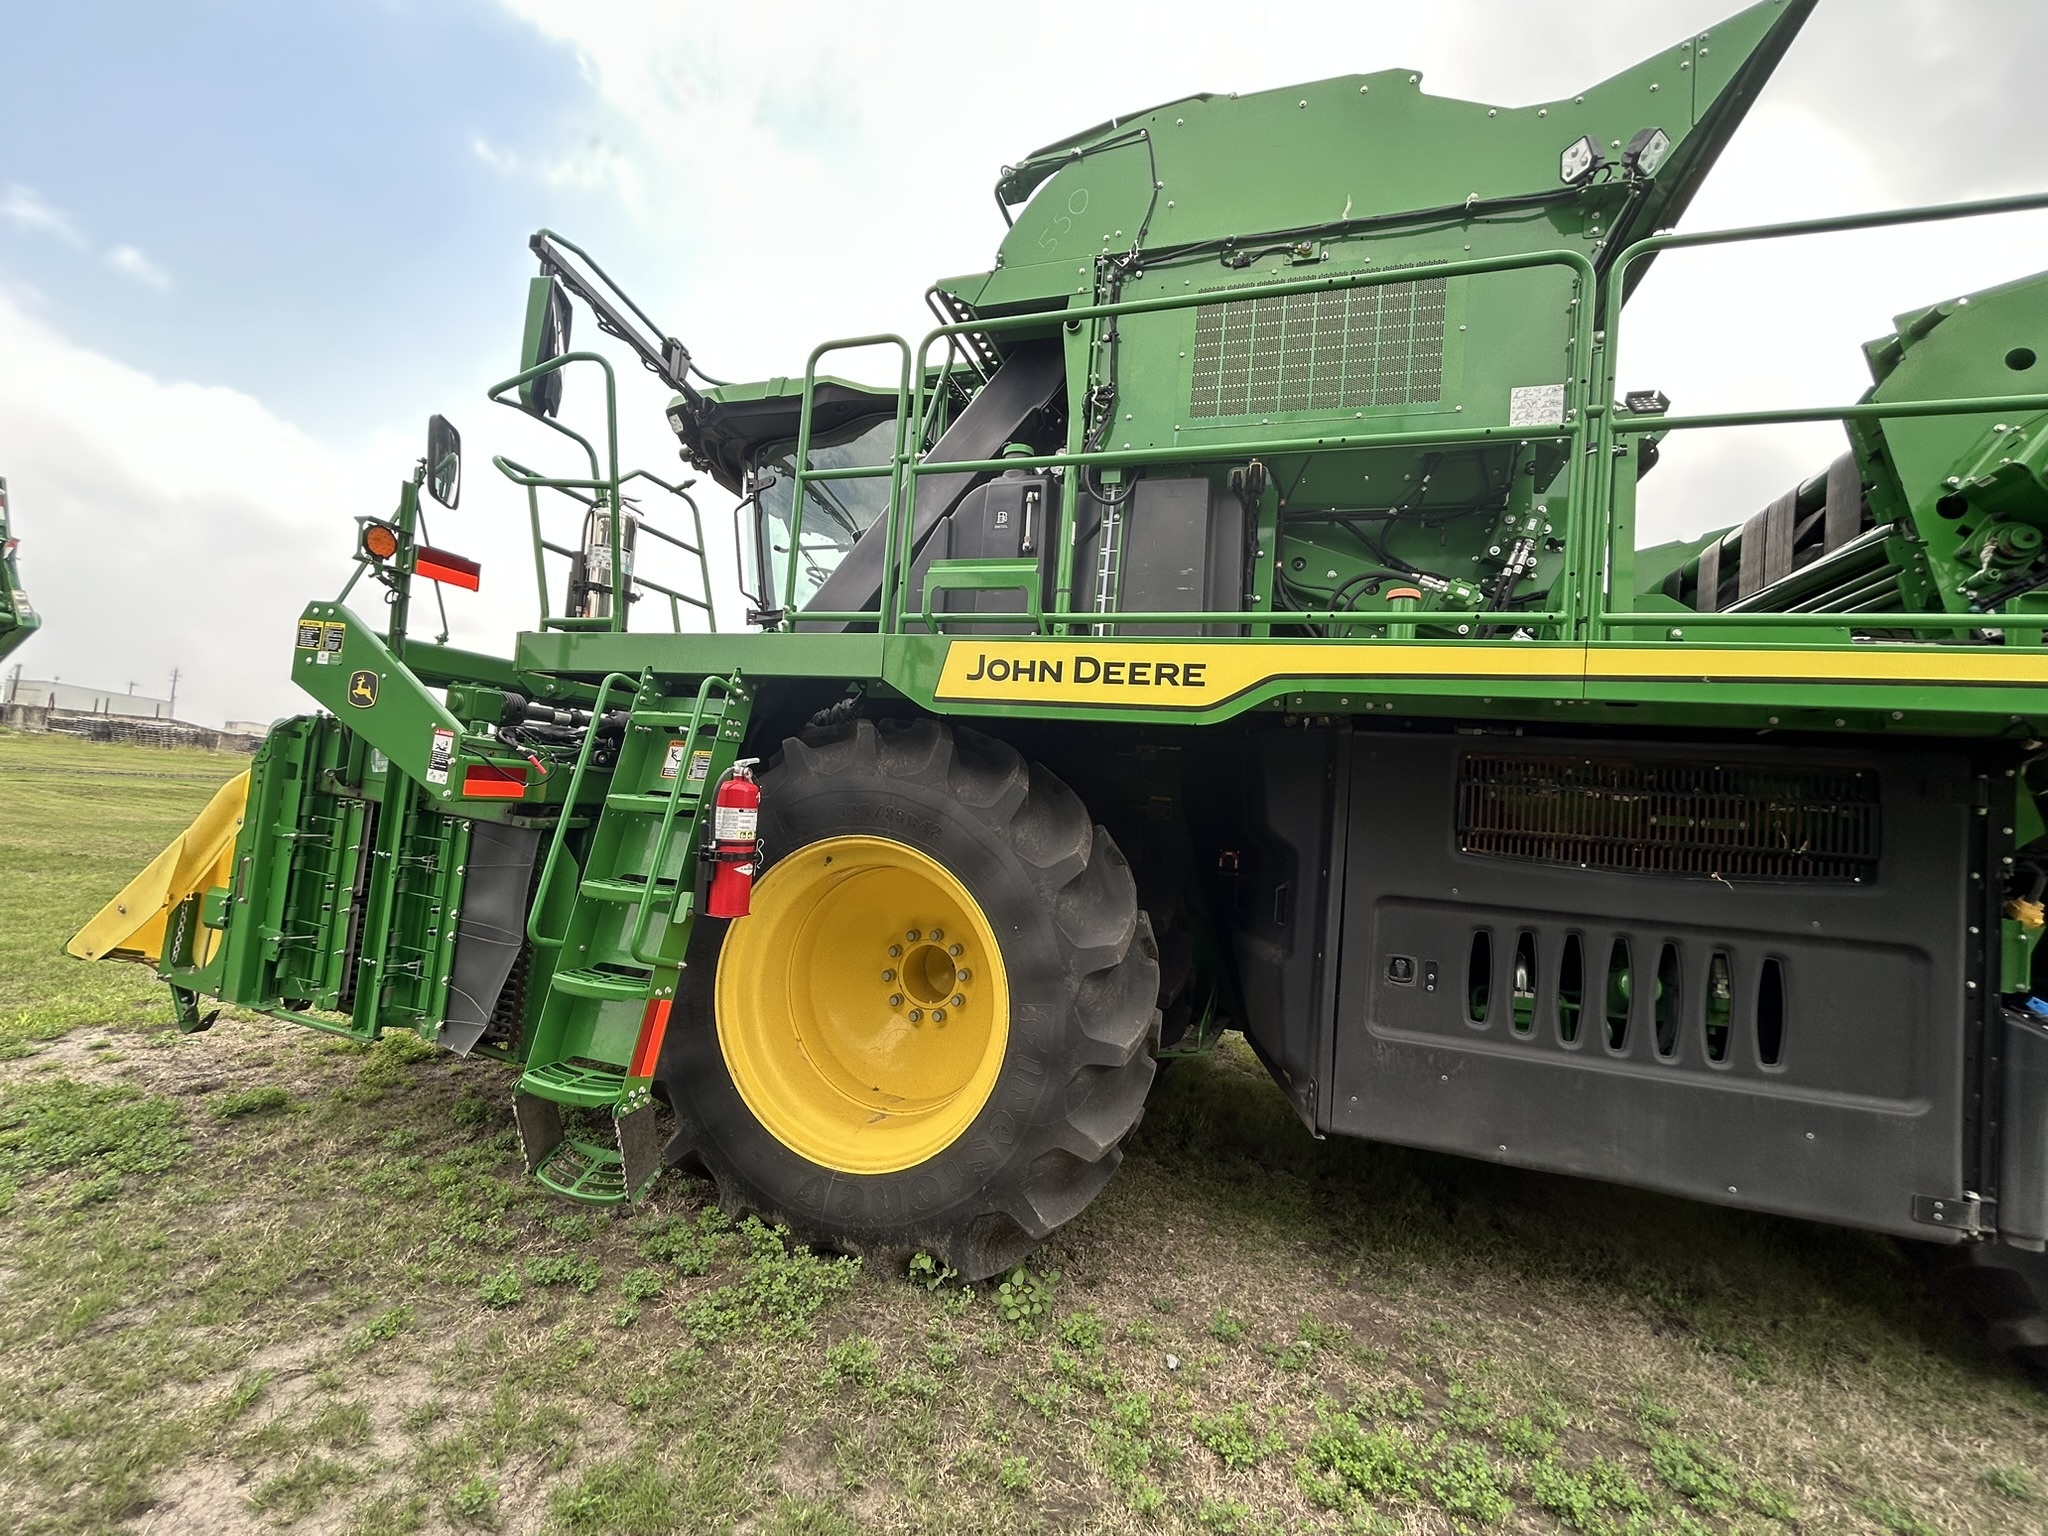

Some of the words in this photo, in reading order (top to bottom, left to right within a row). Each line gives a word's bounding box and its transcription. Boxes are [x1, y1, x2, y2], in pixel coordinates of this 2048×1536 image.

[1037, 188, 1089, 255] 550
[966, 654, 1063, 683] JOHN
[1073, 656, 1207, 687] DEERE
